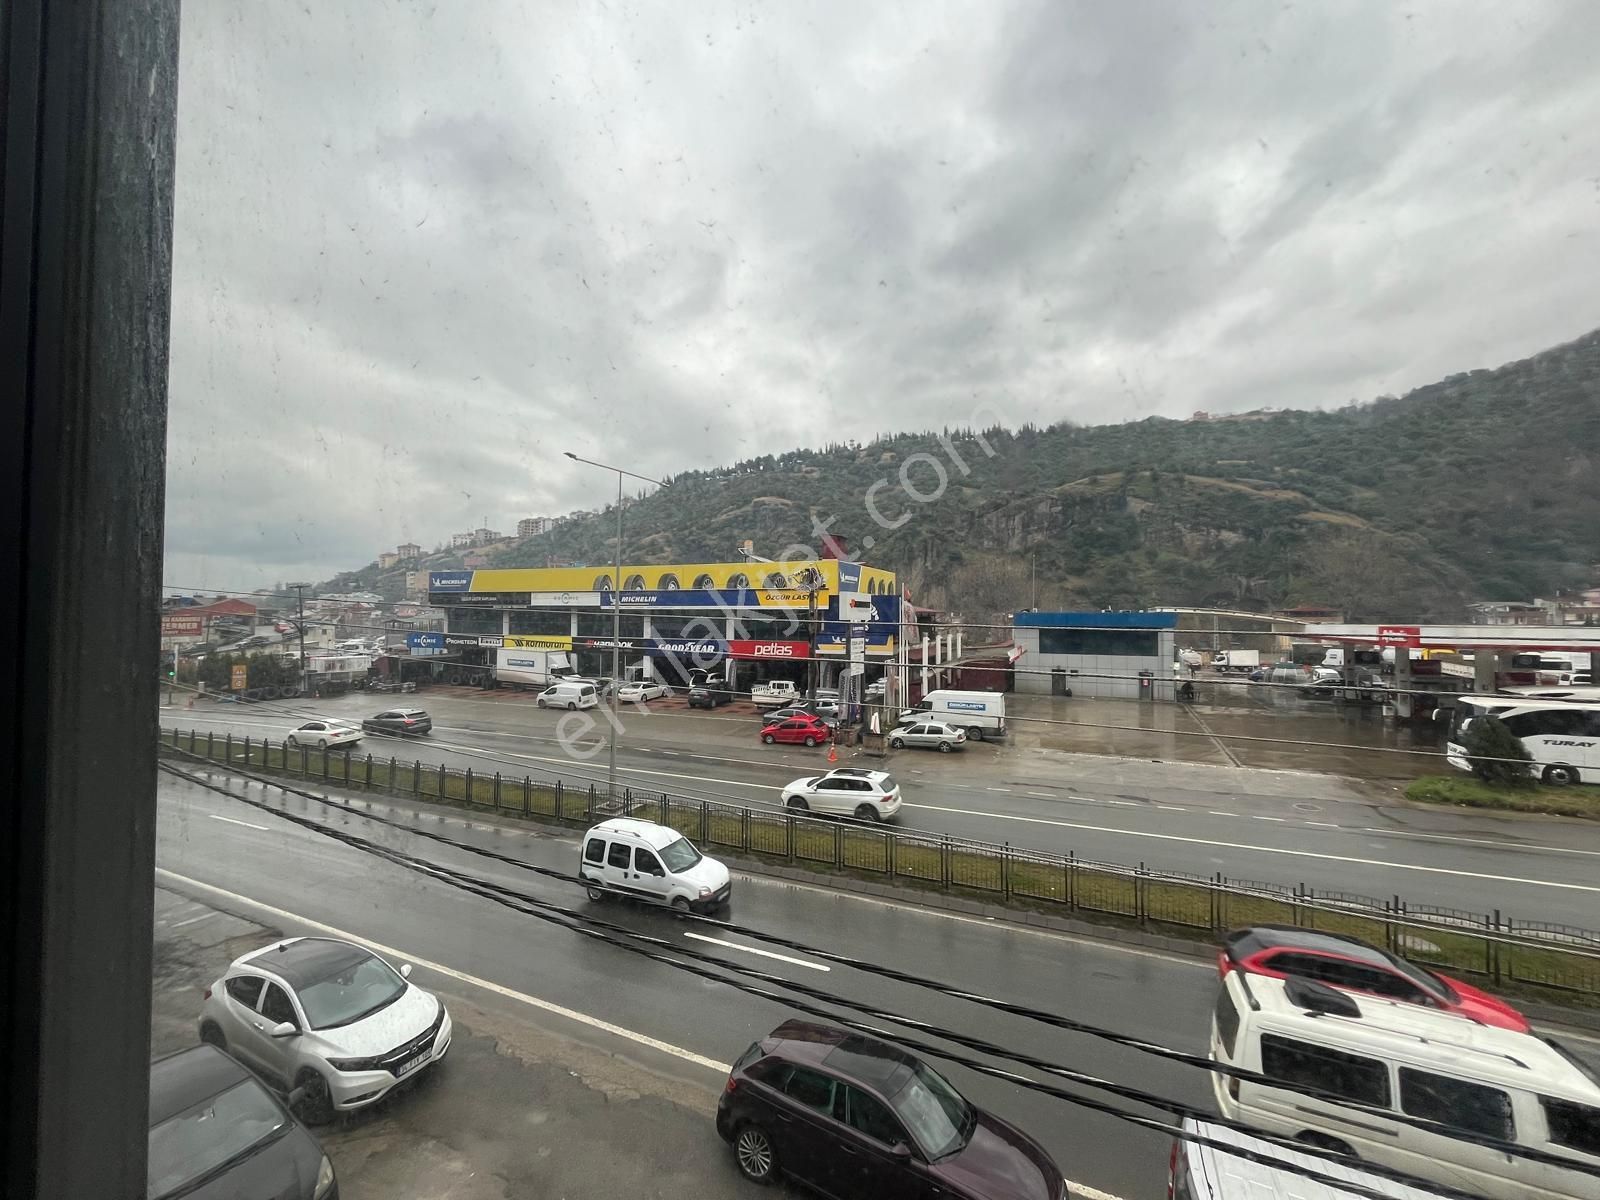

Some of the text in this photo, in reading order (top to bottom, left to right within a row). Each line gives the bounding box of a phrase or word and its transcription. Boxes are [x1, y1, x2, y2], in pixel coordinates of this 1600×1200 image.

[445, 638, 478, 646] PROMETEON
[754, 643, 793, 657] petlas
[1543, 739, 1597, 748] TURAY
